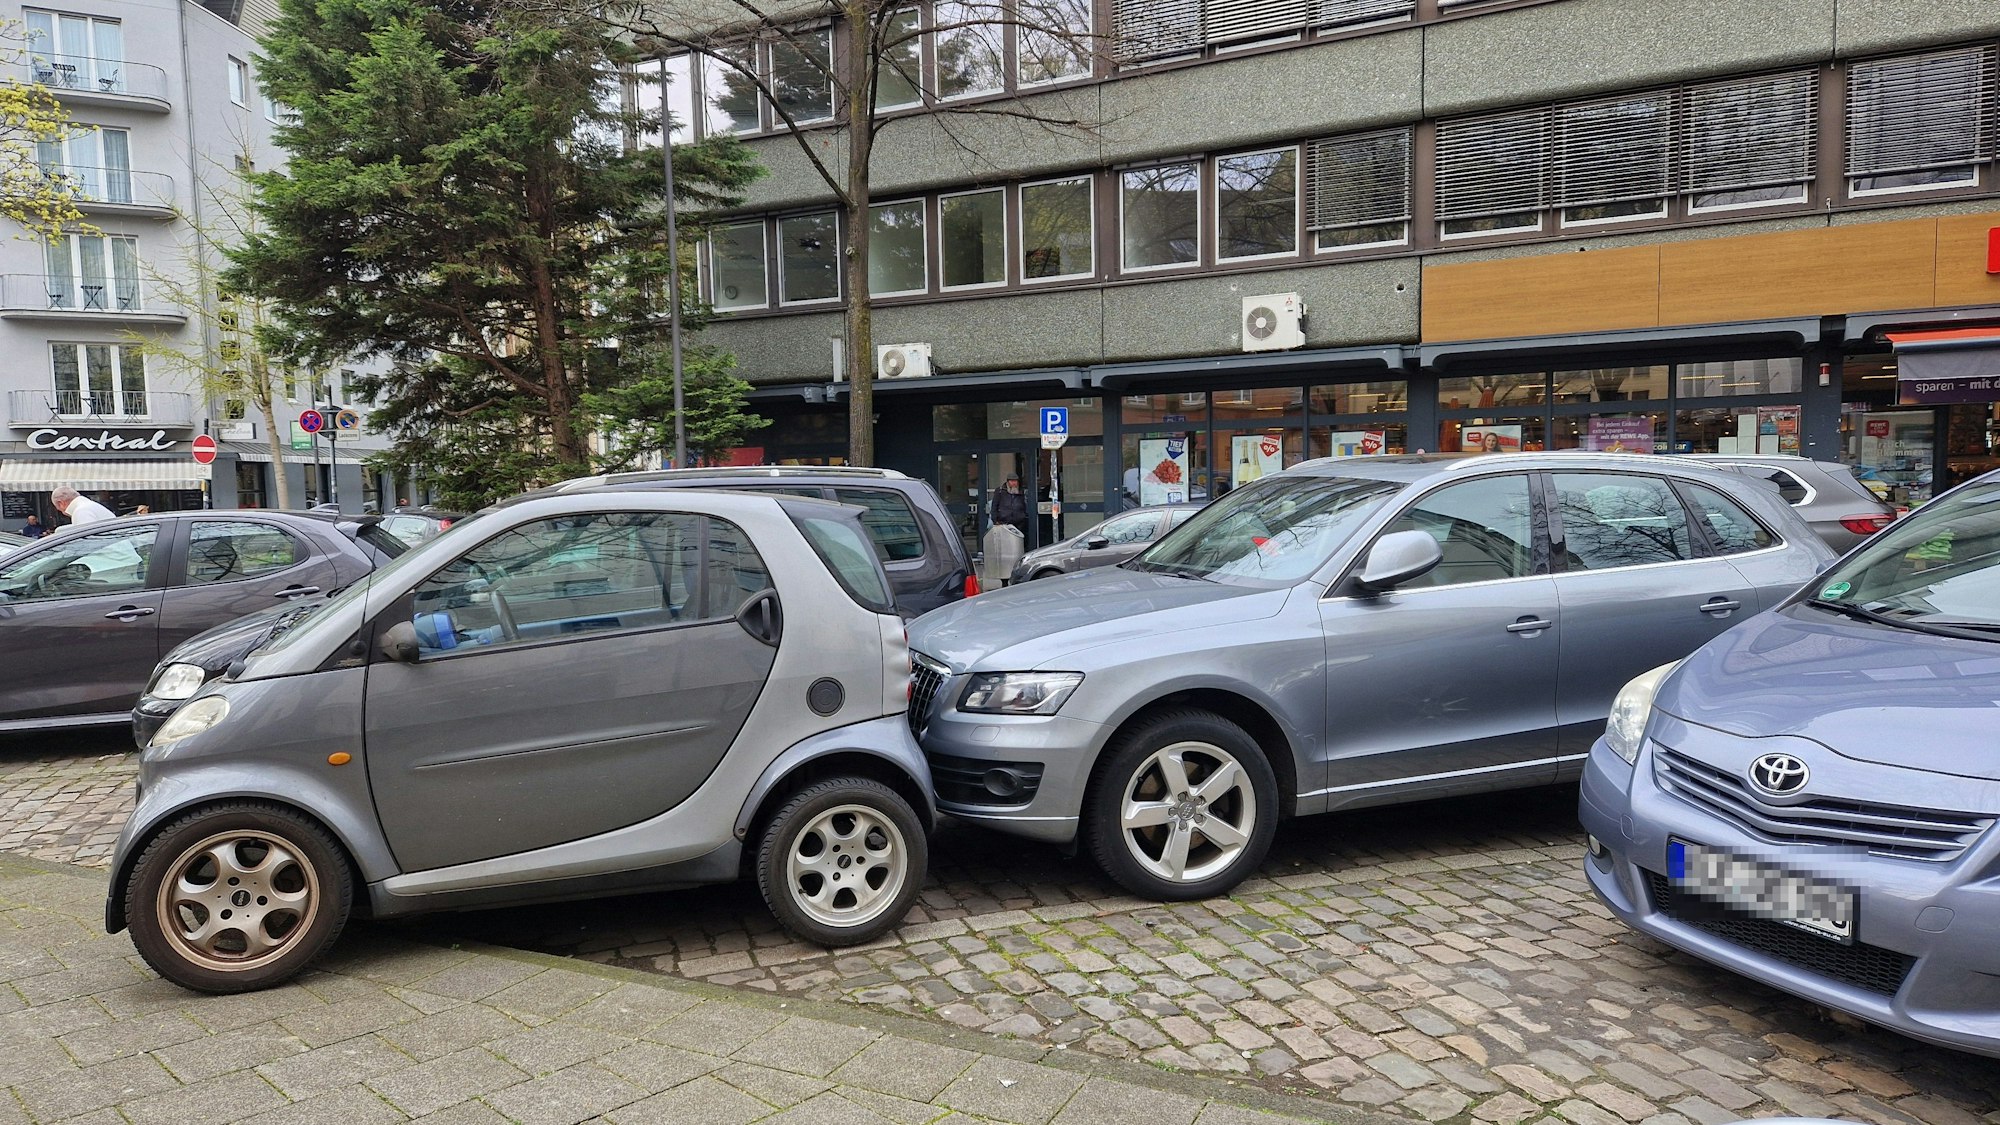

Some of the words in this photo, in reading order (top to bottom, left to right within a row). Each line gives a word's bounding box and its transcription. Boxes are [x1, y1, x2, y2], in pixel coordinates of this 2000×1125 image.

[1915, 382, 1954, 394] sparen
[1969, 378, 1991, 390] mit
[1002, 420, 1010, 428] 15
[1047, 411, 1061, 433] P
[26, 428, 177, 451] Central
